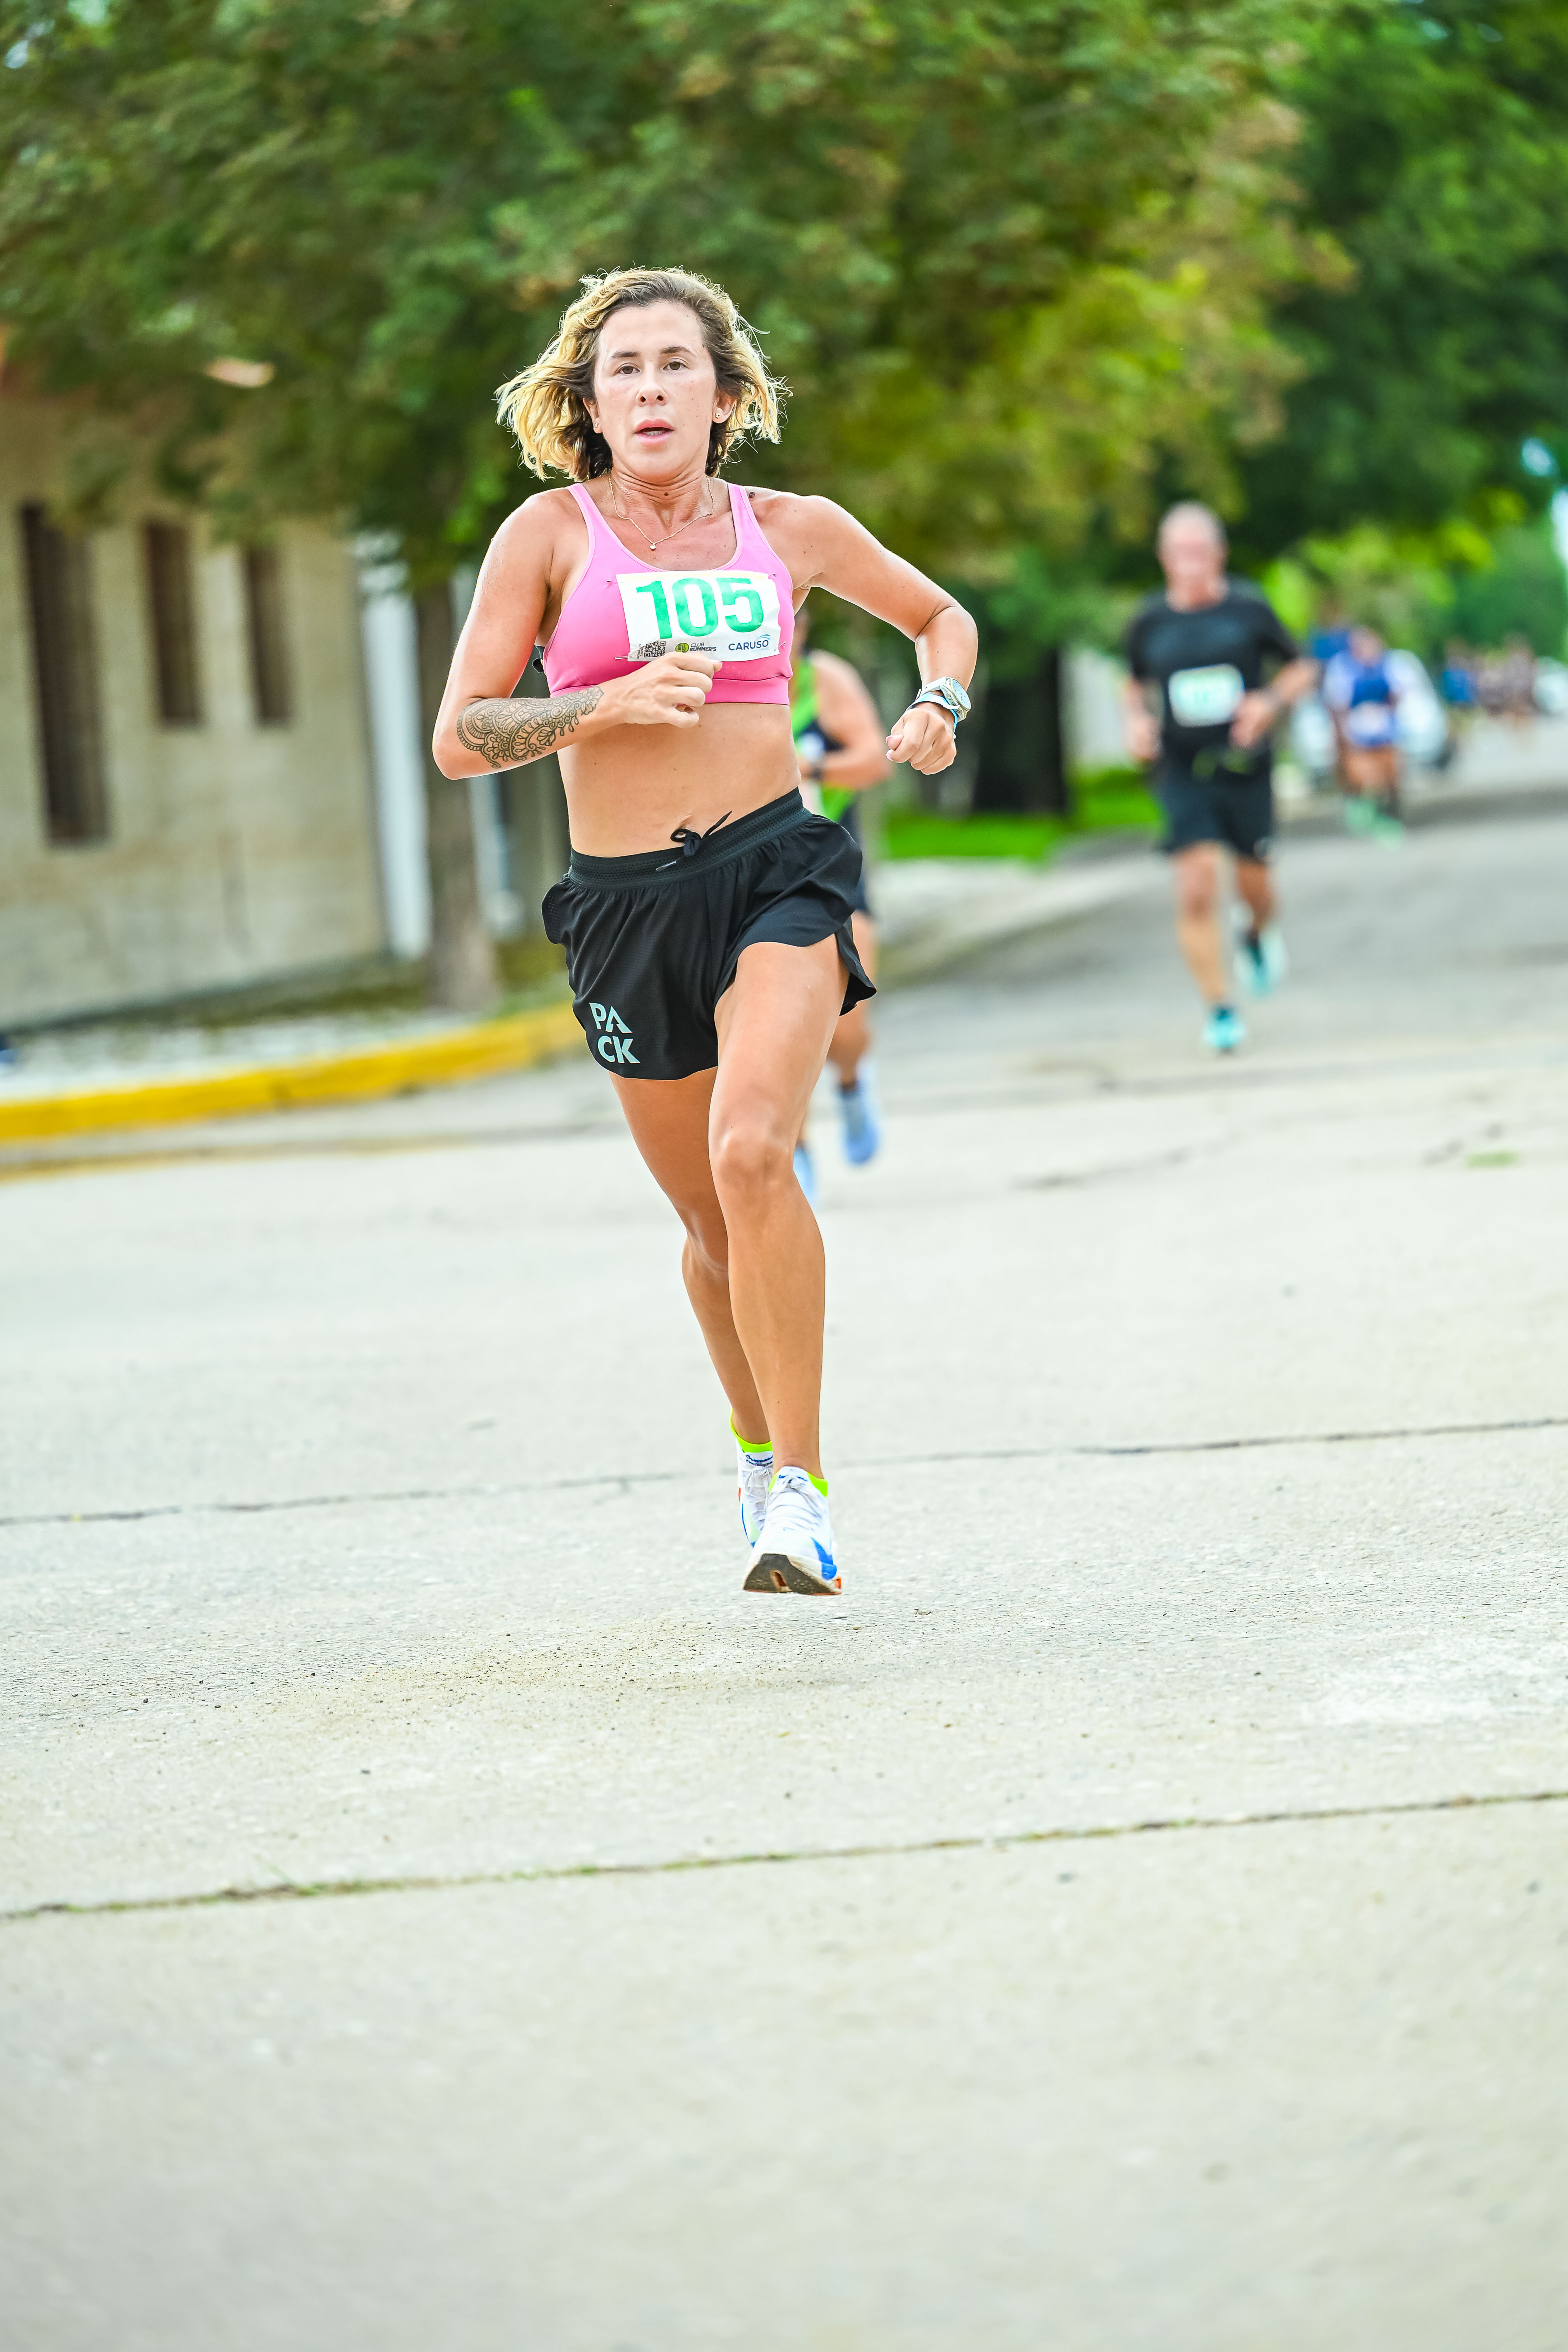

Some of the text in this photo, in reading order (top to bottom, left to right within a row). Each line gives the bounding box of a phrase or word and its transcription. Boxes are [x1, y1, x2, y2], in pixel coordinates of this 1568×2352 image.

[636, 578, 764, 639] 105
[728, 640, 769, 651] CARUSO
[589, 1002, 632, 1033] PA
[598, 1035, 640, 1063] CK
